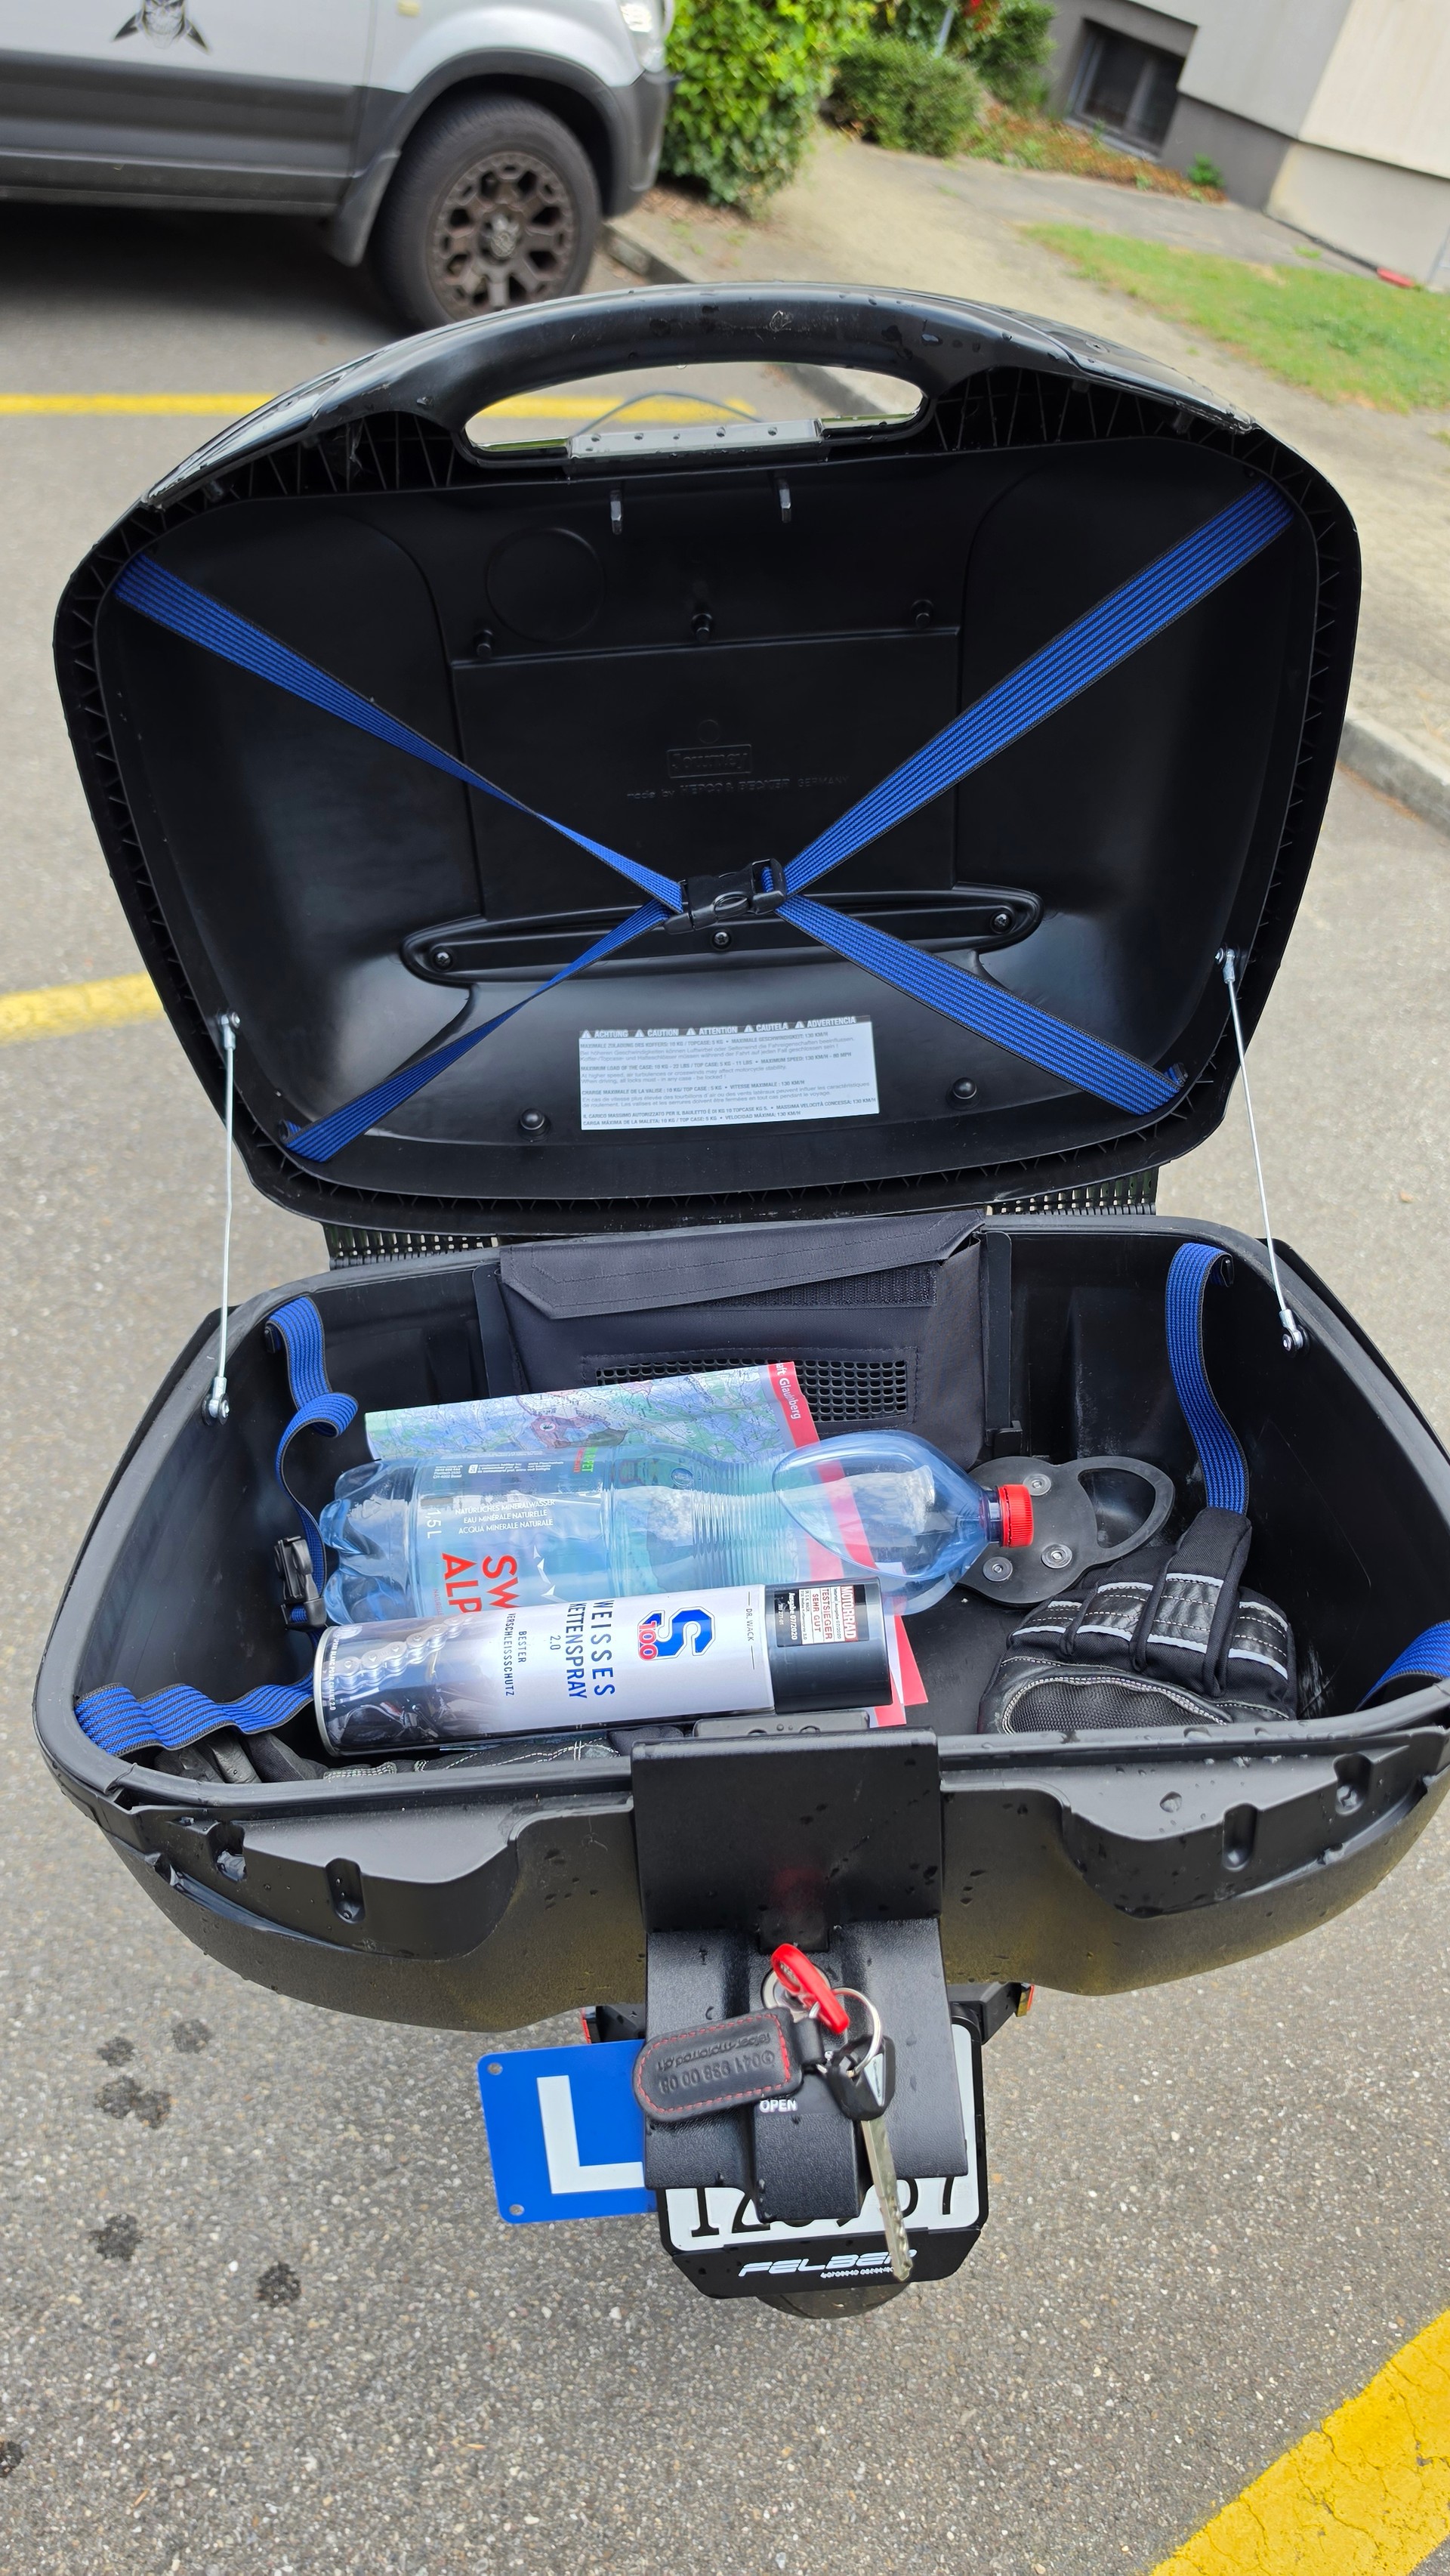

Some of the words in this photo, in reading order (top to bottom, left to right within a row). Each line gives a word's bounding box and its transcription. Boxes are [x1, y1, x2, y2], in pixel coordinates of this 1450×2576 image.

[699, 1026, 738, 1034] ATTENTION
[756, 1023, 788, 1031] CAUTELA
[807, 1017, 856, 1027] ADVERTENCIA
[455, 1504, 500, 1515] NATÜRLICHES
[501, 1499, 555, 1511] MINERALWASSER
[479, 1512, 511, 1522] MINÉRALE
[512, 1509, 548, 1519] NATURELLE
[424, 1509, 442, 1528] 1,5
[458, 1526, 484, 1535] ACQUA
[486, 1522, 519, 1532] MINERALE
[520, 1518, 554, 1528] NATURALE
[427, 1530, 442, 1539] L
[787, 1592, 797, 1614] Ausgabe
[841, 1586, 857, 1639] MOTORRAD
[822, 1589, 833, 1640] TESTSIEGER
[746, 1620, 754, 1642] WACK
[789, 1614, 798, 1640] 07/2020
[517, 1630, 527, 1663] BESTER
[550, 1635, 561, 1651] 2.0
[566, 1602, 588, 1699] KETTENSPRAY
[591, 1600, 615, 1696] WEISSES
[504, 1613, 517, 1697] VERSCHLEISSSCHUTZ
[760, 2099, 798, 2113] OPEN
[536, 2075, 645, 2195] L
